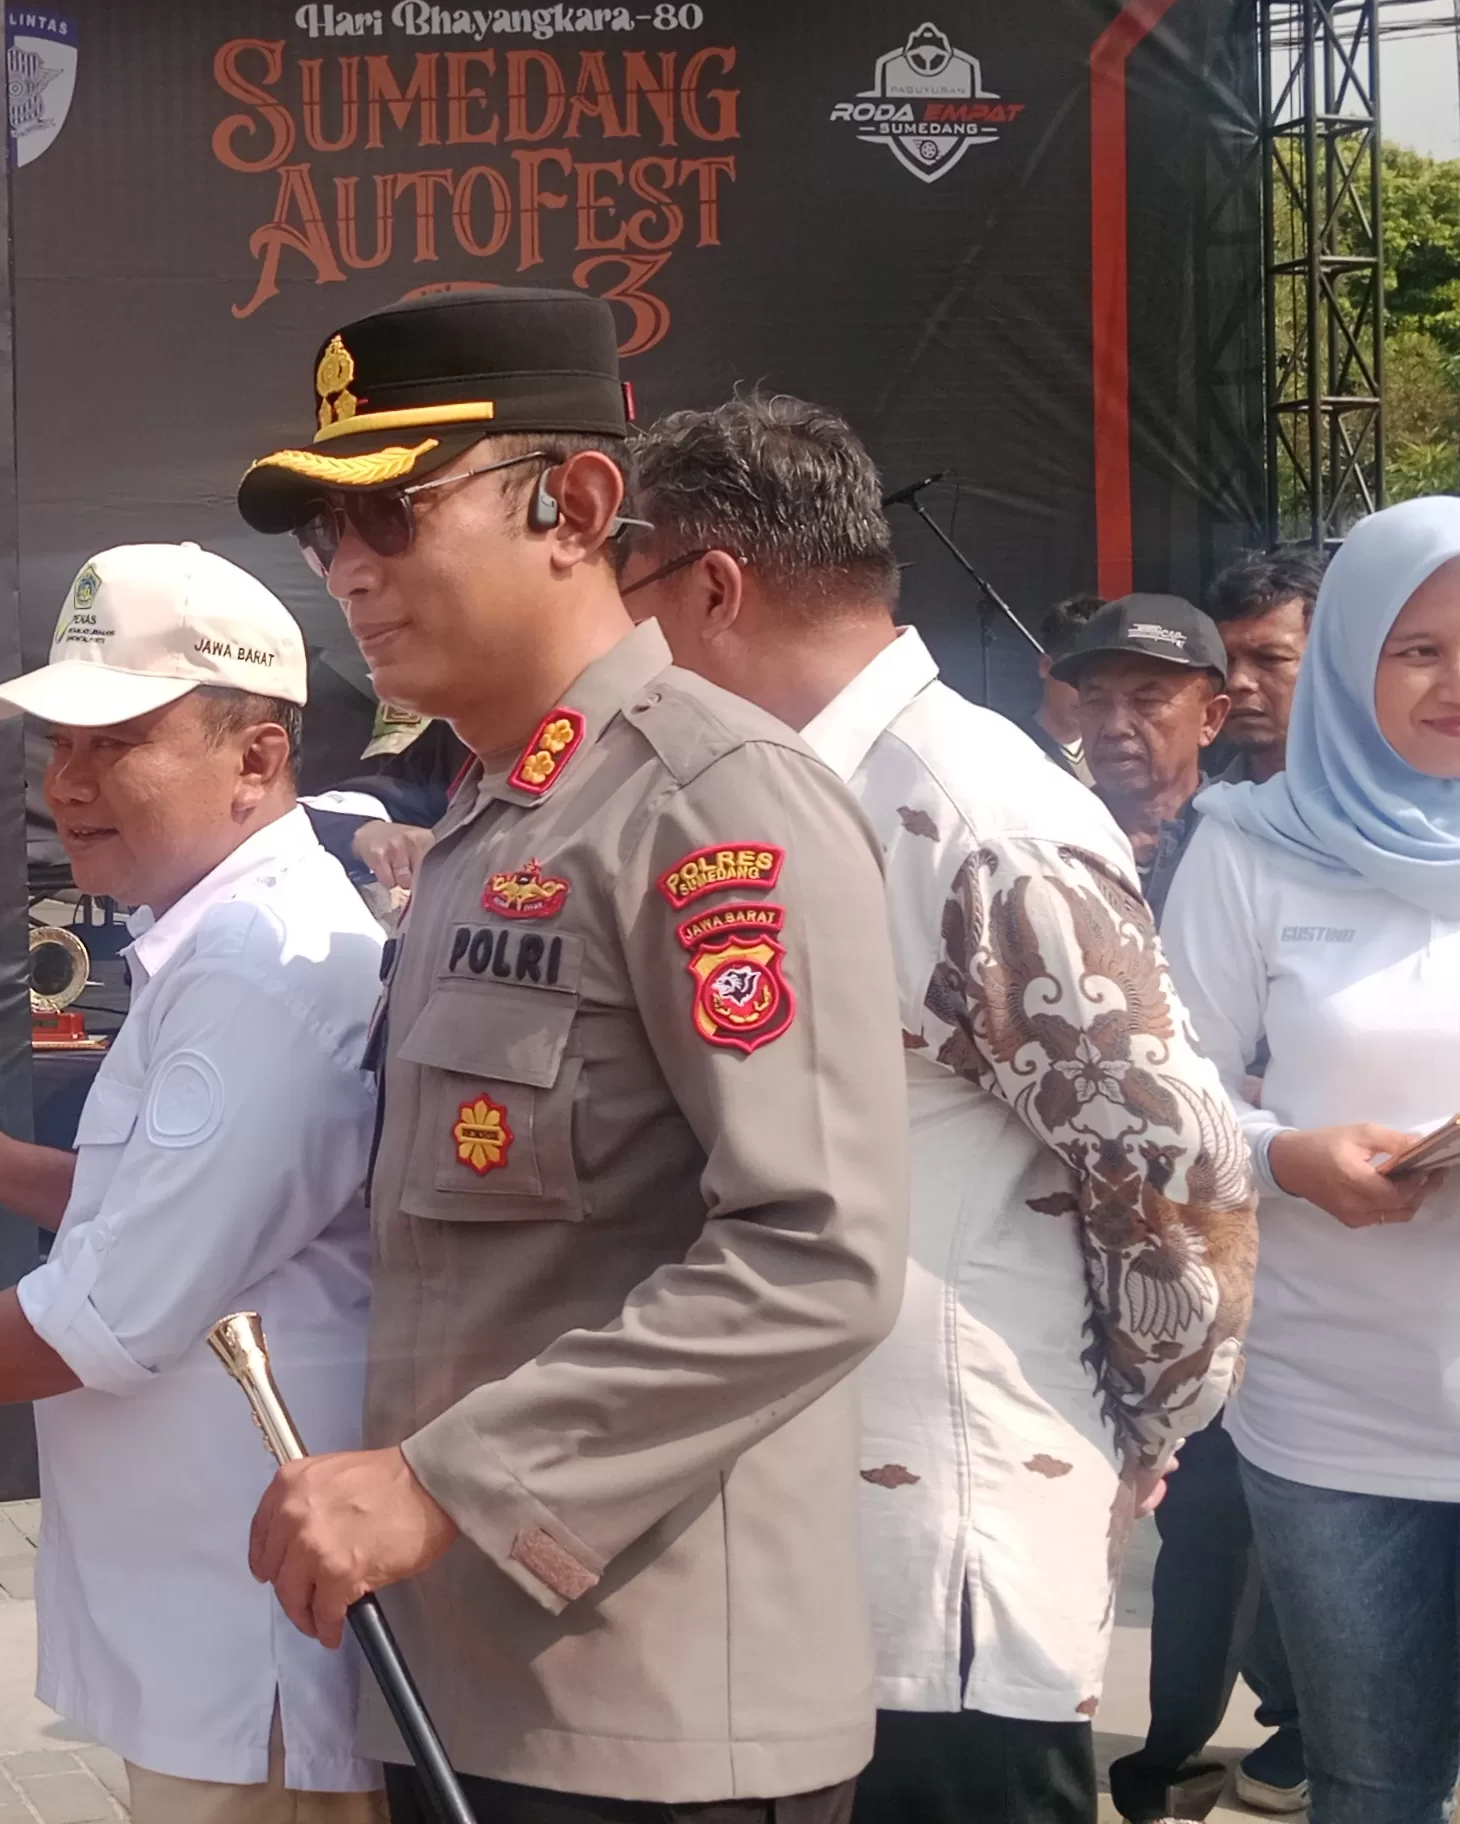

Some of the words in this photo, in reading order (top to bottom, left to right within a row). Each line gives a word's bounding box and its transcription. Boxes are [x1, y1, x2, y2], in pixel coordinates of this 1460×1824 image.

[9, 13, 68, 35] LINTAS
[295, 4, 383, 38] Hari
[392, 0, 704, 41] Bhayangkara-80
[212, 39, 741, 172] SUMEDANG
[830, 103, 914, 121] RODA
[923, 104, 1025, 122] EMPAT
[879, 123, 978, 134] SUMEDANG
[231, 147, 736, 319] AUTOFEST
[194, 638, 232, 659] JAWA
[237, 648, 275, 667] BARAT
[666, 851, 774, 895] POLRES
[679, 867, 760, 896] SUMEDANG
[686, 916, 723, 940] JAWA
[725, 910, 775, 924] BARAT
[448, 927, 562, 985] POLRI
